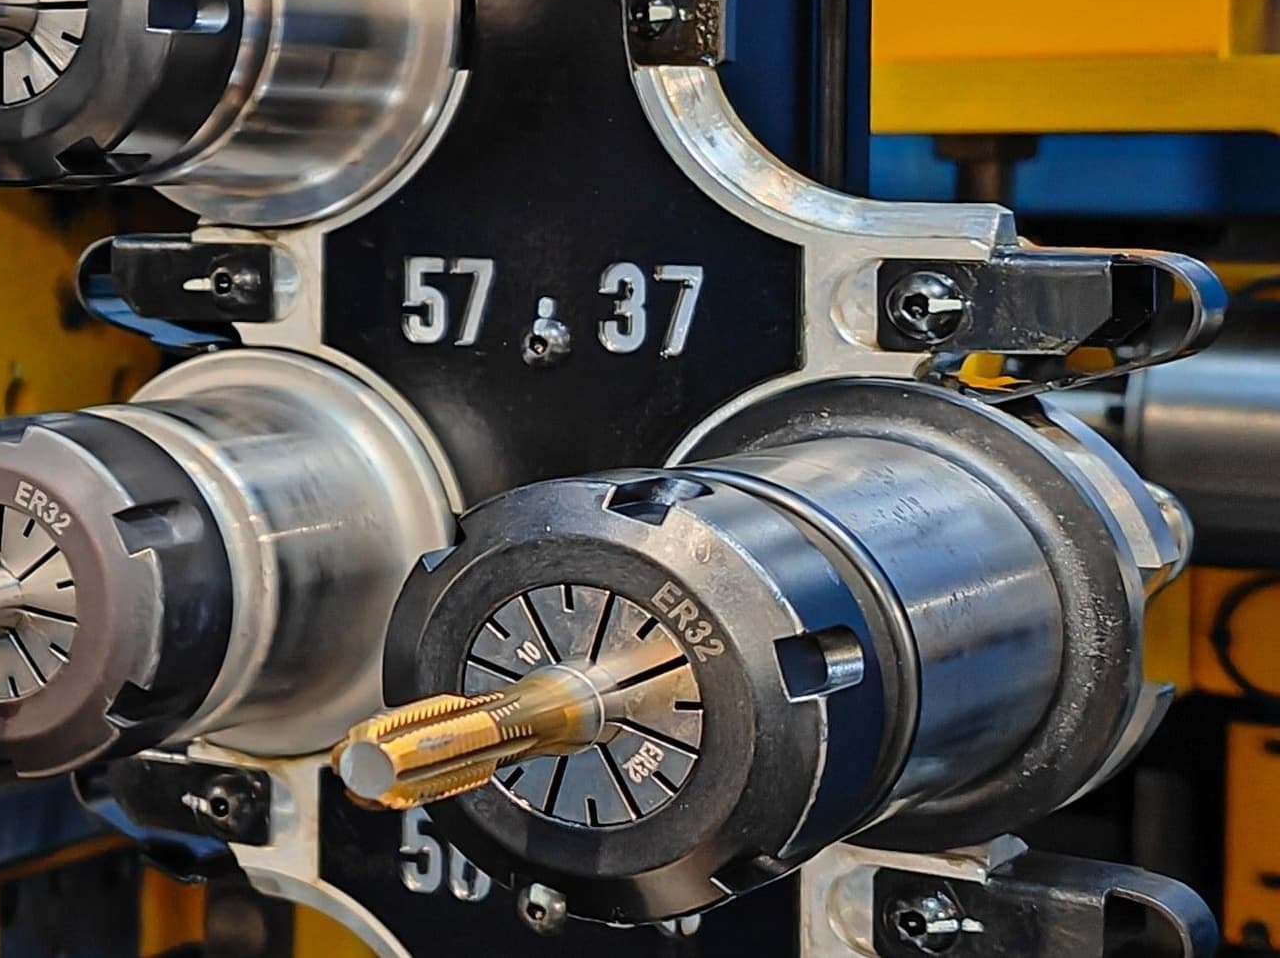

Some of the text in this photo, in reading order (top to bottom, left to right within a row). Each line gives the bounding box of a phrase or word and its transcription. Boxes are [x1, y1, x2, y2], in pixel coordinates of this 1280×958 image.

[400, 256, 704, 360] 57 37
[14, 480, 72, 536] ER32
[650, 580, 726, 664] ER32
[515, 640, 542, 666] 10
[621, 740, 665, 784] ER32
